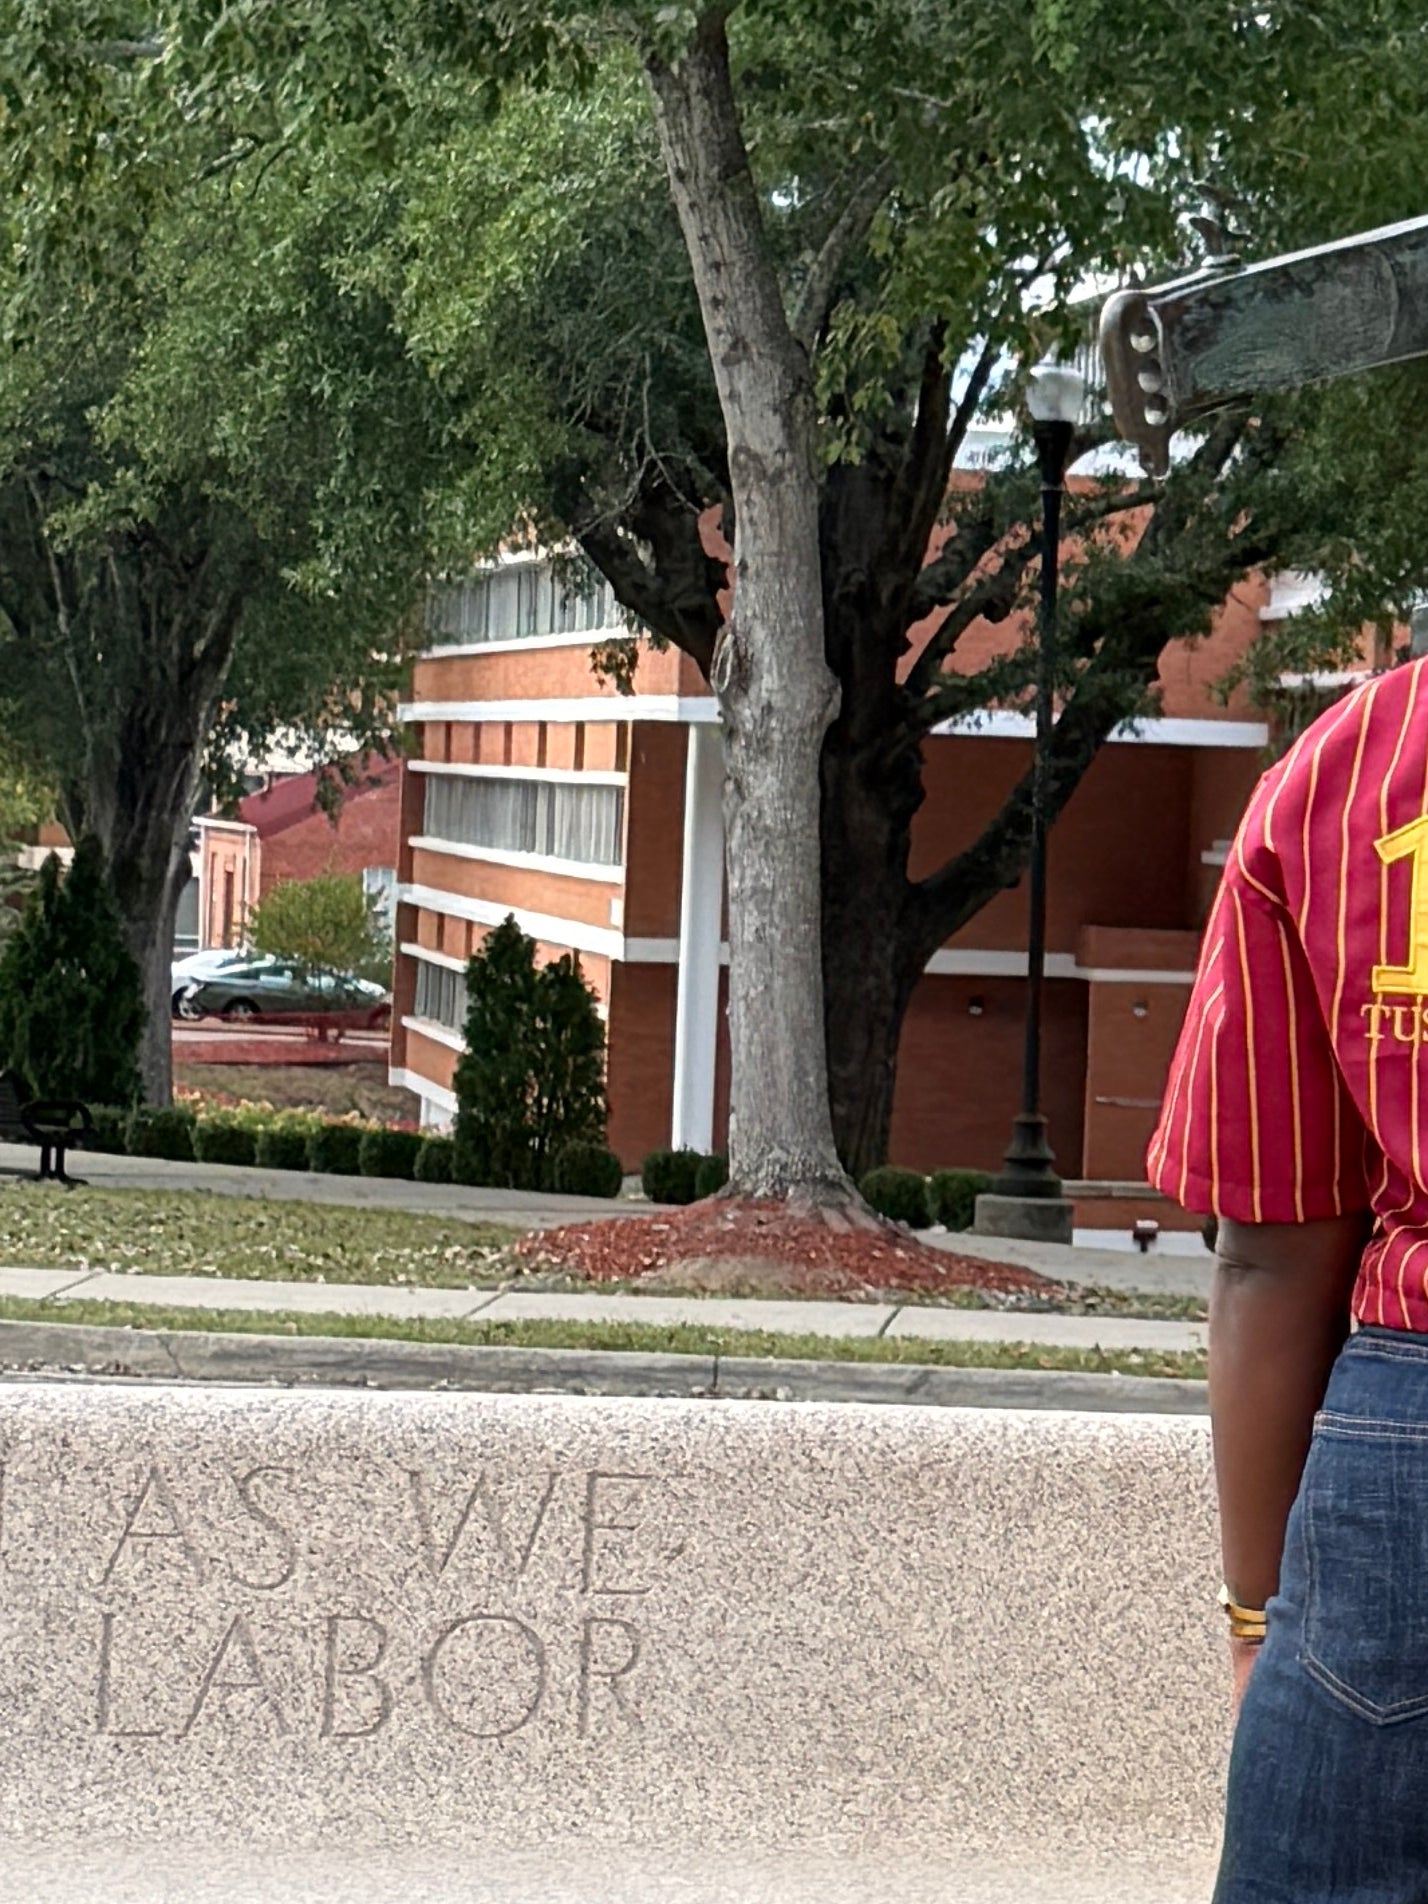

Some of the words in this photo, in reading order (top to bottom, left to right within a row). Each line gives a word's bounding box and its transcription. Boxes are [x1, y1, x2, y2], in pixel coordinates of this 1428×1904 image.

[93, 1464, 300, 1591] AS
[403, 1468, 654, 1595] WE
[97, 1612, 642, 1741] LABOR
